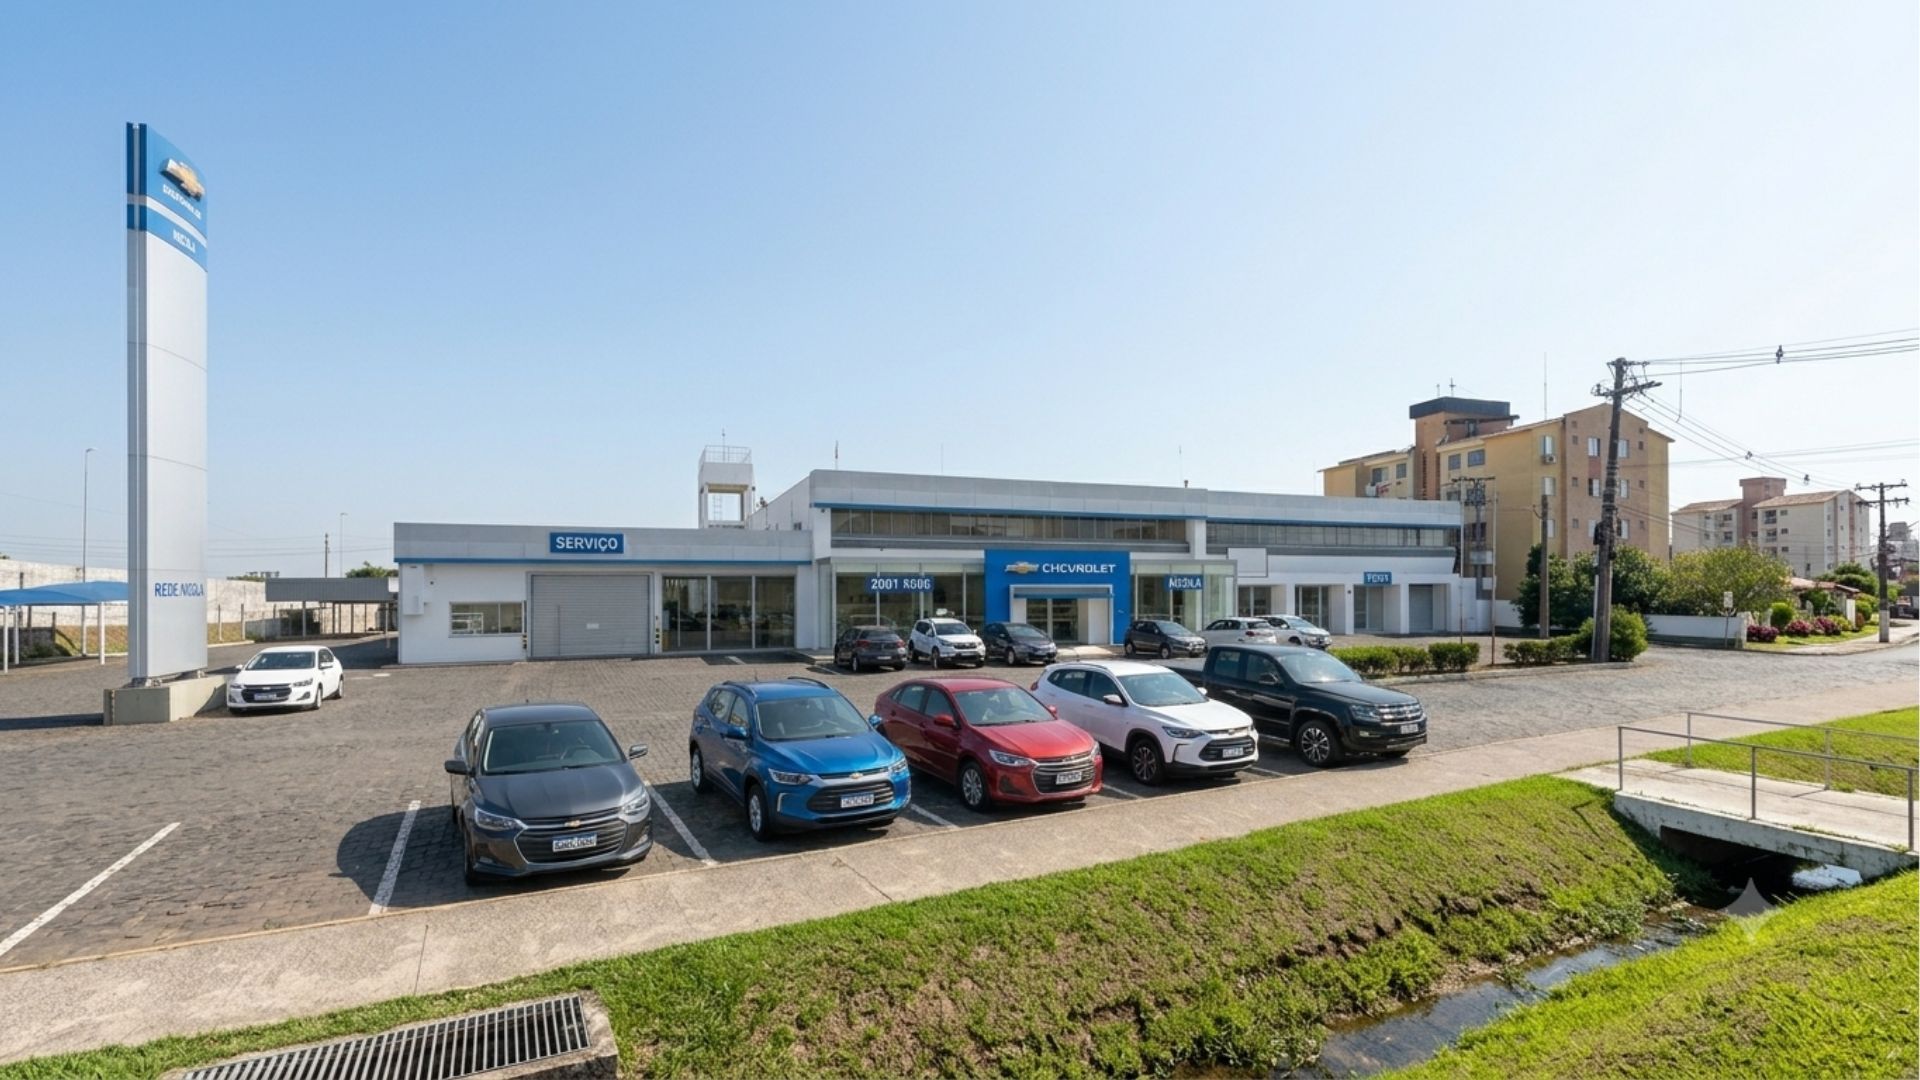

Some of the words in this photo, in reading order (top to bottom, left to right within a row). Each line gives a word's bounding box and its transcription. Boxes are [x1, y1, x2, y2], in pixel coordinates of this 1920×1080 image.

[555, 536, 618, 552] SERVIÇO
[154, 582, 179, 597] REDE
[871, 578, 898, 590] 2001
